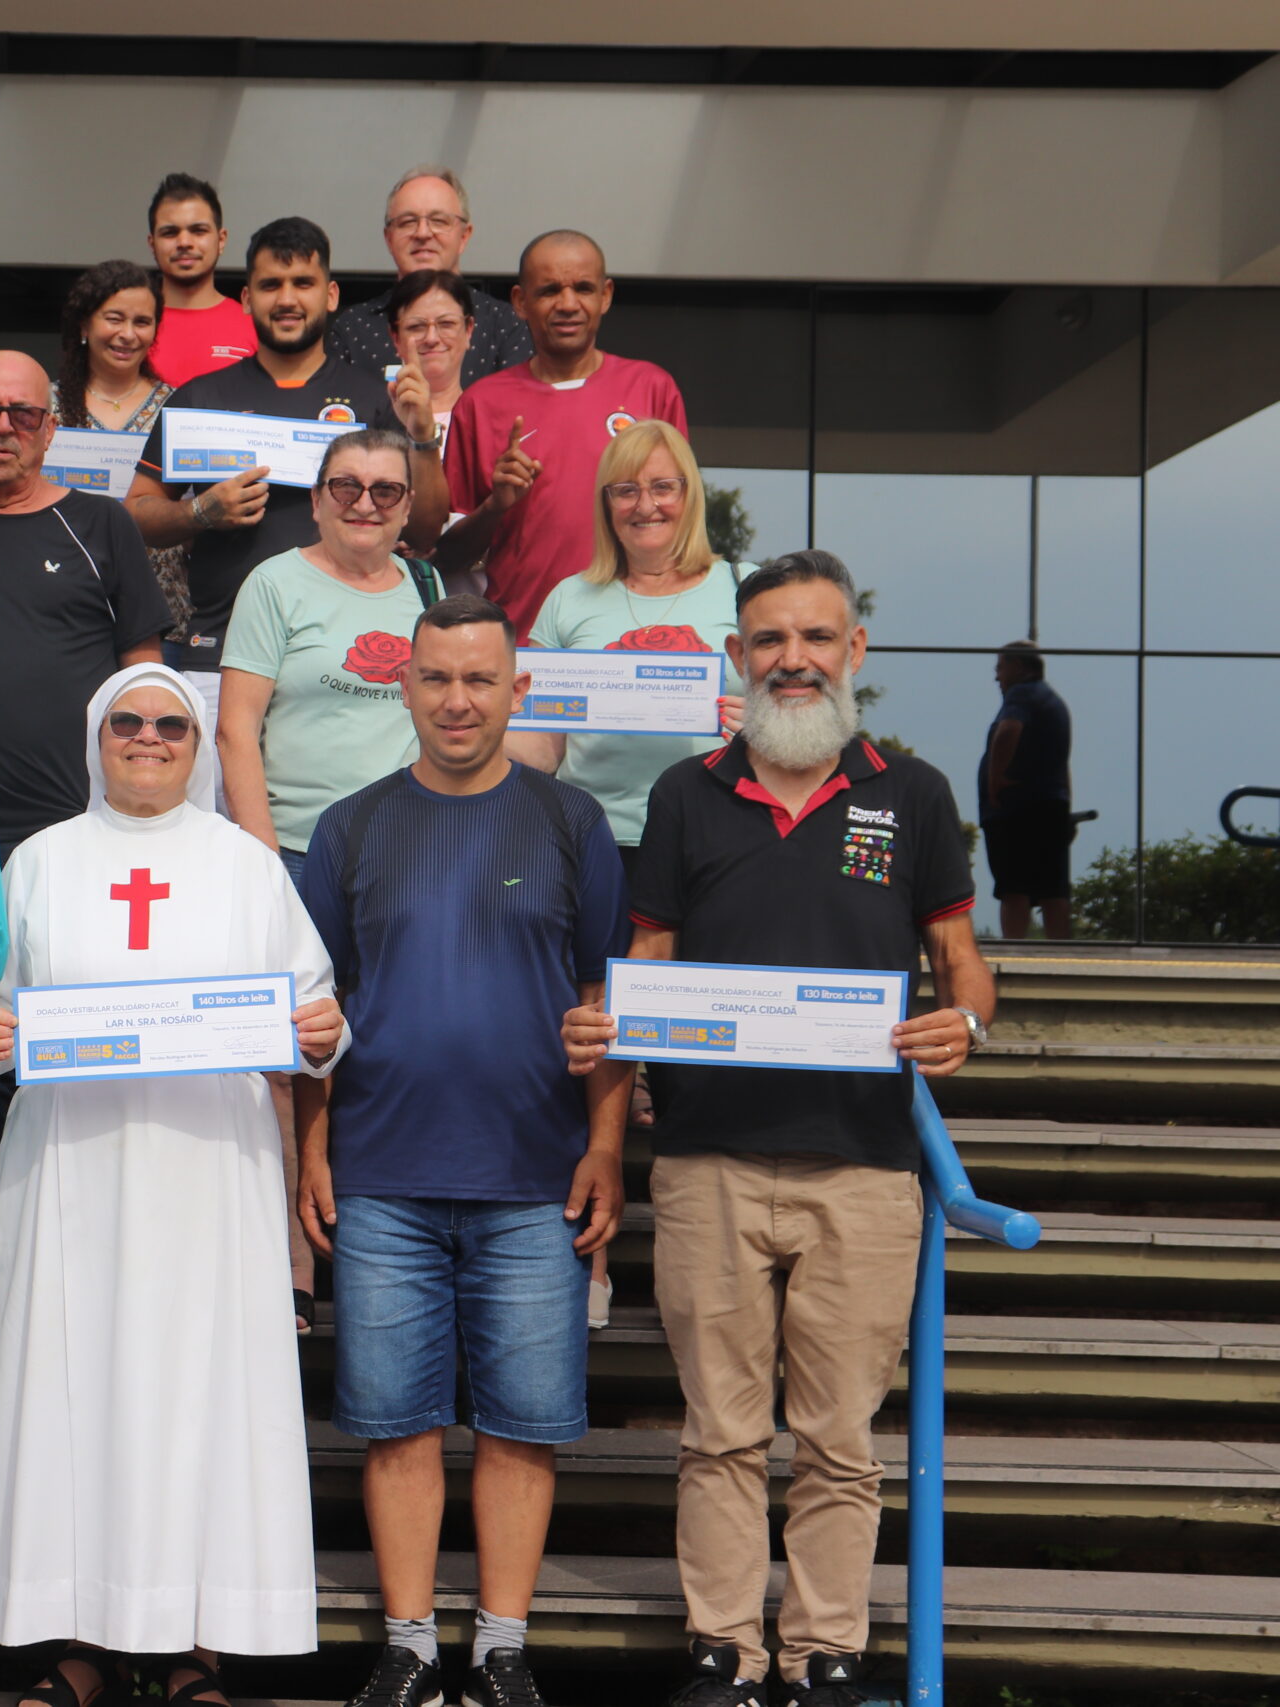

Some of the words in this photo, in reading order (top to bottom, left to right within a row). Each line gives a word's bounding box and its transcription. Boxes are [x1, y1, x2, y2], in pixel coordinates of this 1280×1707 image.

[320, 674, 330, 684] O
[330, 678, 352, 694] QUE
[352, 686, 381, 700] MOVE
[382, 690, 389, 700] A
[545, 680, 585, 689] COMBATE
[555, 702, 564, 714] 5
[848, 804, 895, 819] PREMIA
[848, 812, 894, 825] MOTOS
[844, 834, 896, 850] CRIANÇA
[630, 983, 664, 992] DOAÇÃO
[666, 986, 710, 994] VESTIBULAR
[752, 990, 782, 998] FACCAT
[803, 989, 820, 998] 130
[821, 990, 844, 1000] litros
[844, 990, 858, 1000] de
[858, 991, 879, 1001] leite
[198, 996, 214, 1006] 140
[216, 995, 236, 1005] litros
[238, 994, 250, 1003] de
[251, 993, 269, 1002] leite
[36, 1006, 68, 1016] DOAÇÃO
[69, 1005, 110, 1014] VESTIBULAR
[152, 1001, 180, 1009] FACCAT
[711, 1003, 756, 1015] CRIANÇA
[759, 1004, 797, 1015] CIDADÃ
[105, 1020, 124, 1028] LAR
[126, 1018, 136, 1027] N.
[138, 1016, 158, 1026] SRA.
[160, 1014, 204, 1025] ROSÁRIO
[627, 1030, 658, 1038] BULAR
[696, 1028, 708, 1042] 5
[36, 1052, 67, 1061] BULAR
[102, 1044, 113, 1058] 5
